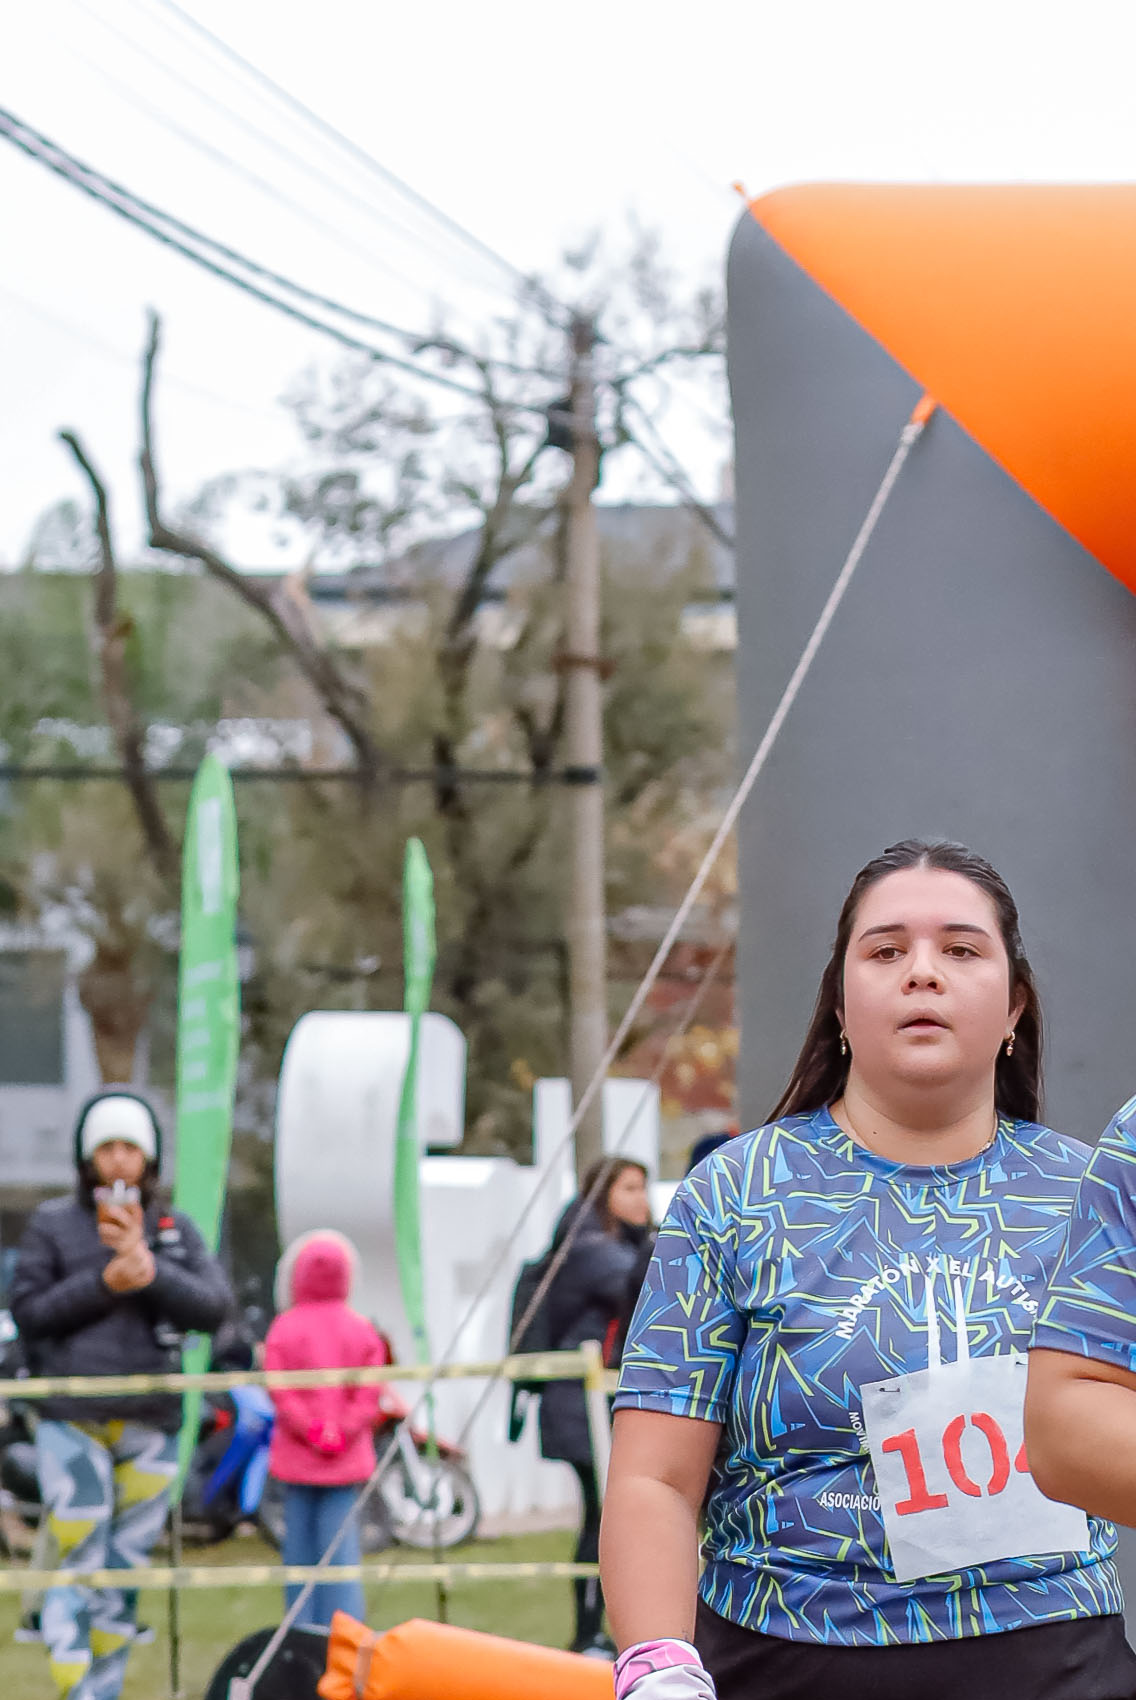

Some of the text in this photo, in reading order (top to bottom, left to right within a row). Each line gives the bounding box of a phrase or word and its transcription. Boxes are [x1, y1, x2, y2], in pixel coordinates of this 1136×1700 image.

[925, 1256, 944, 1274] X
[950, 1259, 973, 1278] EL
[881, 1412, 1031, 1516] 10
